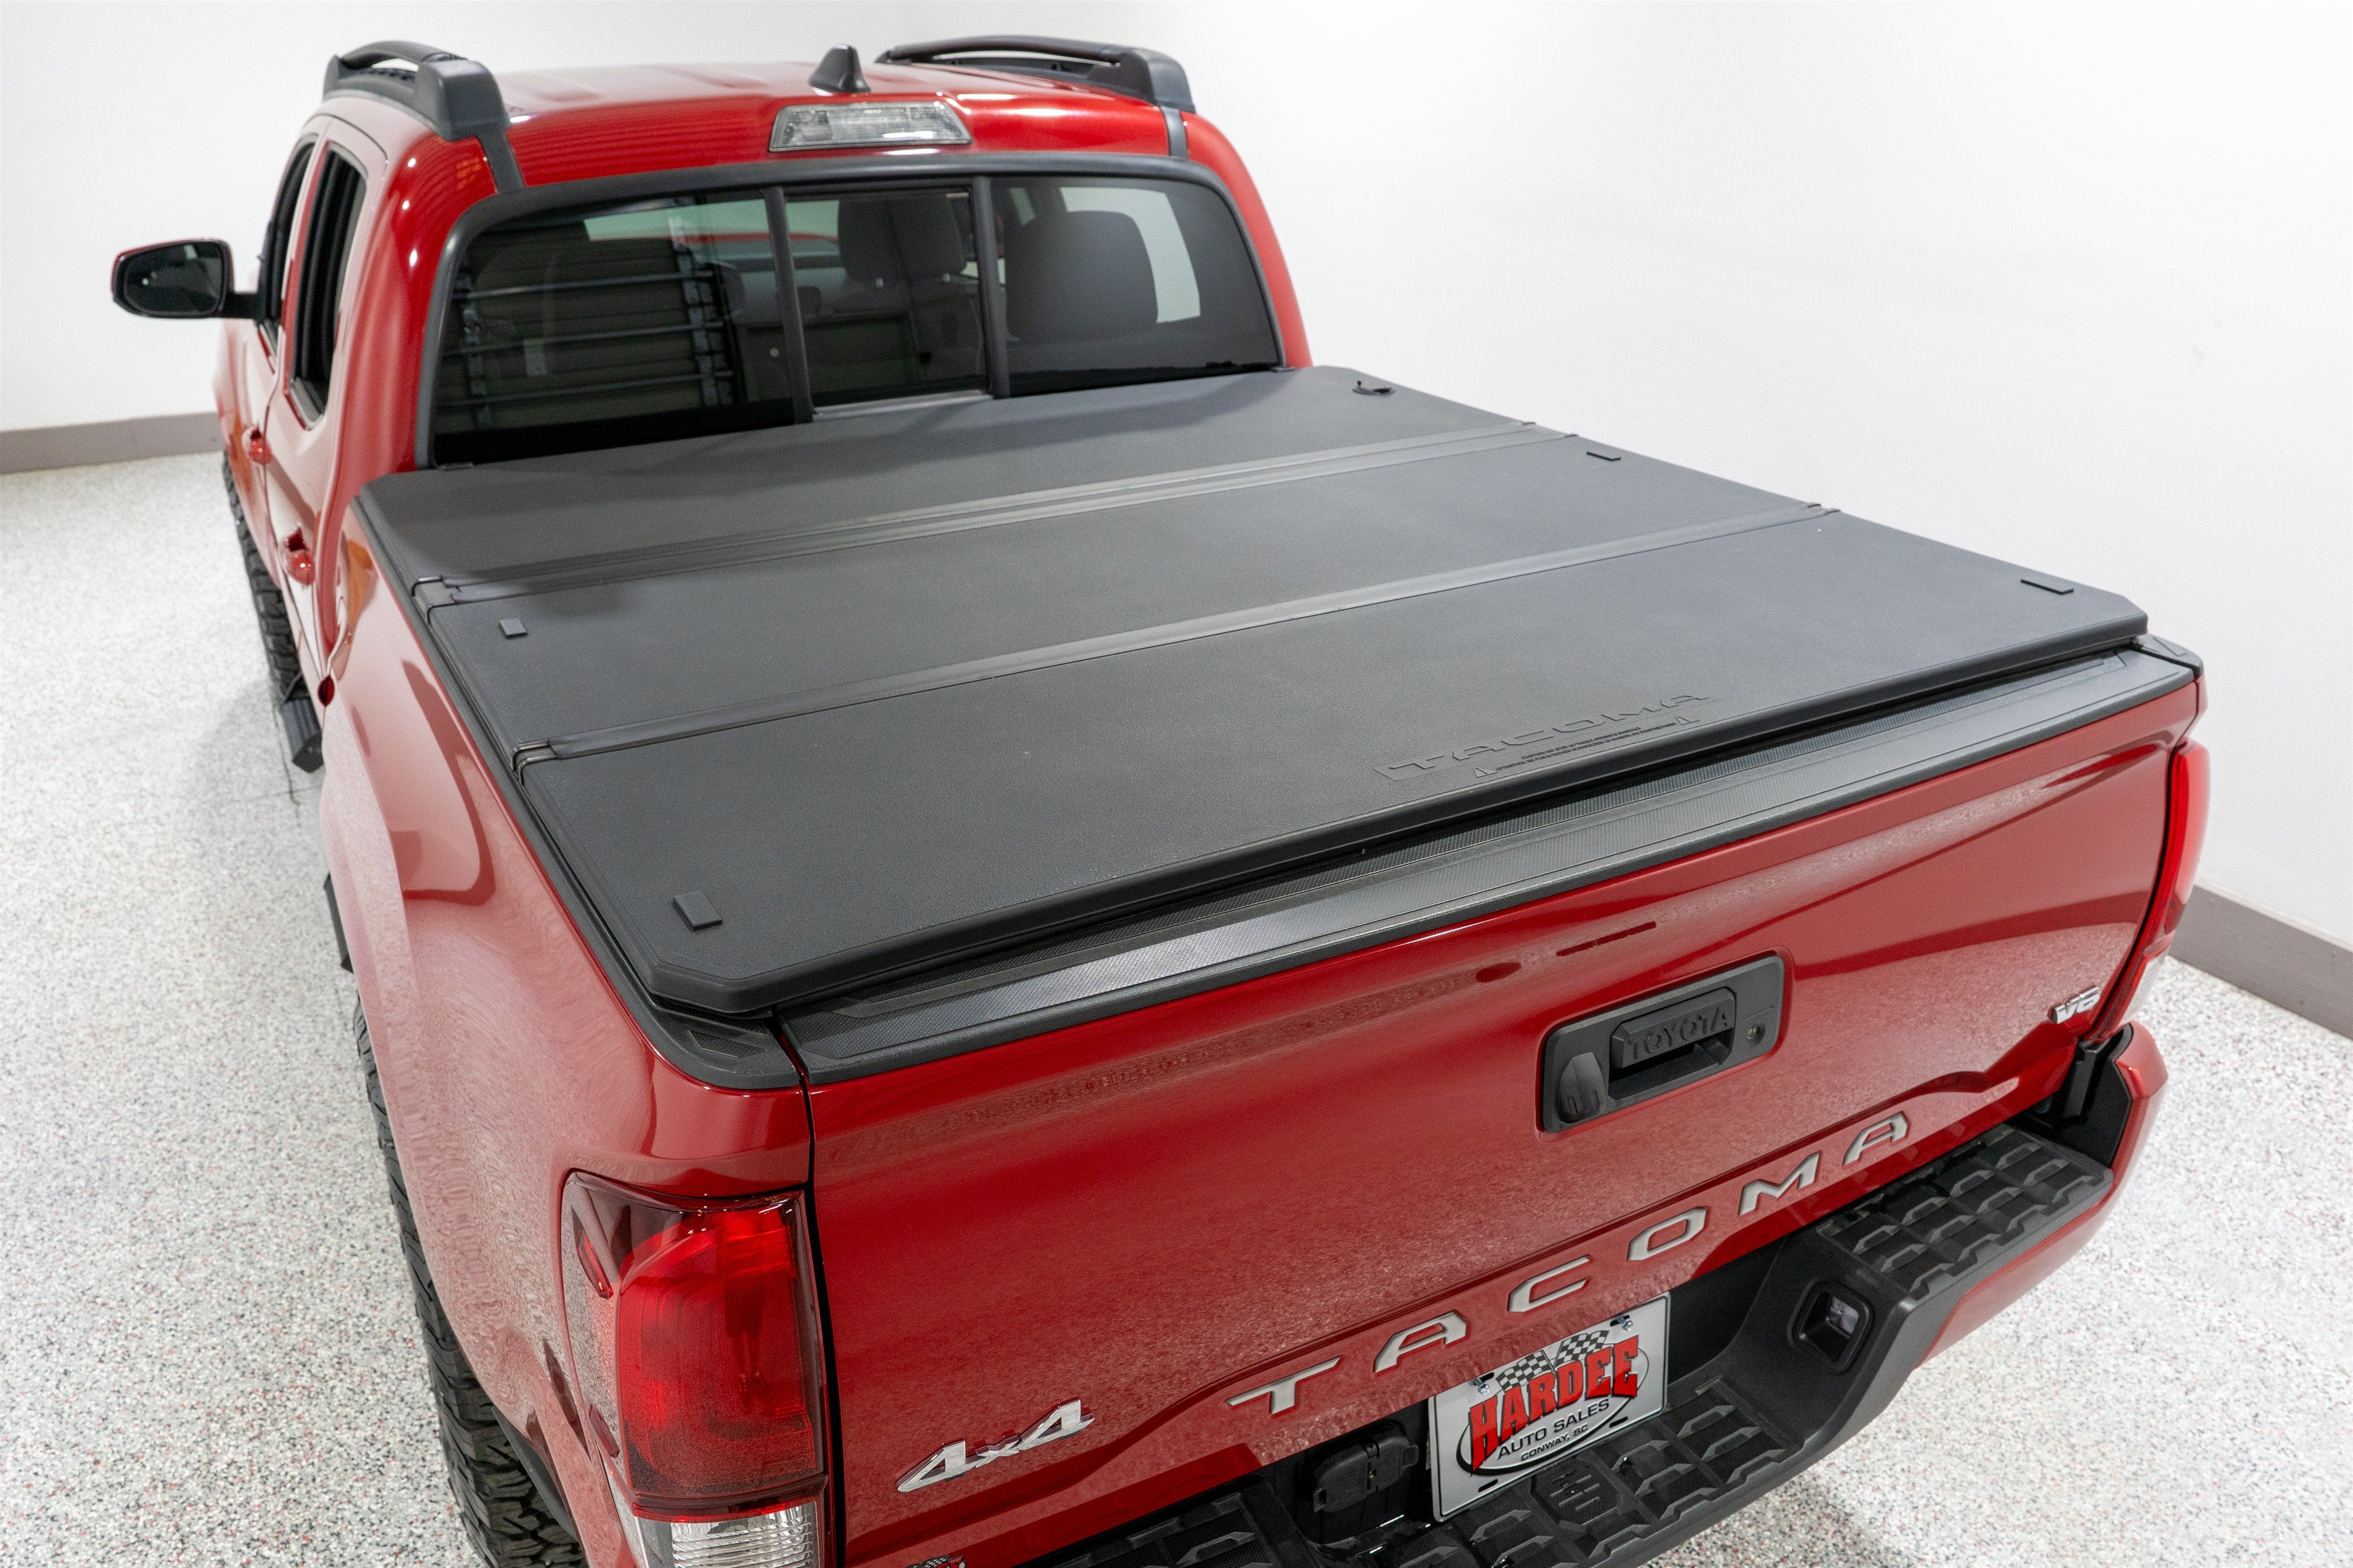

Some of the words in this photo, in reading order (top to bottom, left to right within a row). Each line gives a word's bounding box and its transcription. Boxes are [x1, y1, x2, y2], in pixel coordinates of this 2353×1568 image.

[1387, 695, 1710, 770] TACOMA
[1627, 1006, 1728, 1060] TOYOTA
[2053, 986, 2101, 1024] V6
[1225, 1111, 1909, 1415] TACOMA
[1468, 1335, 1639, 1473] HARDEE
[1497, 1428, 1546, 1461] AUTO
[1553, 1398, 1610, 1434] SALES
[1521, 1434, 1571, 1461] CONWAY,
[1573, 1424, 1589, 1436] SC
